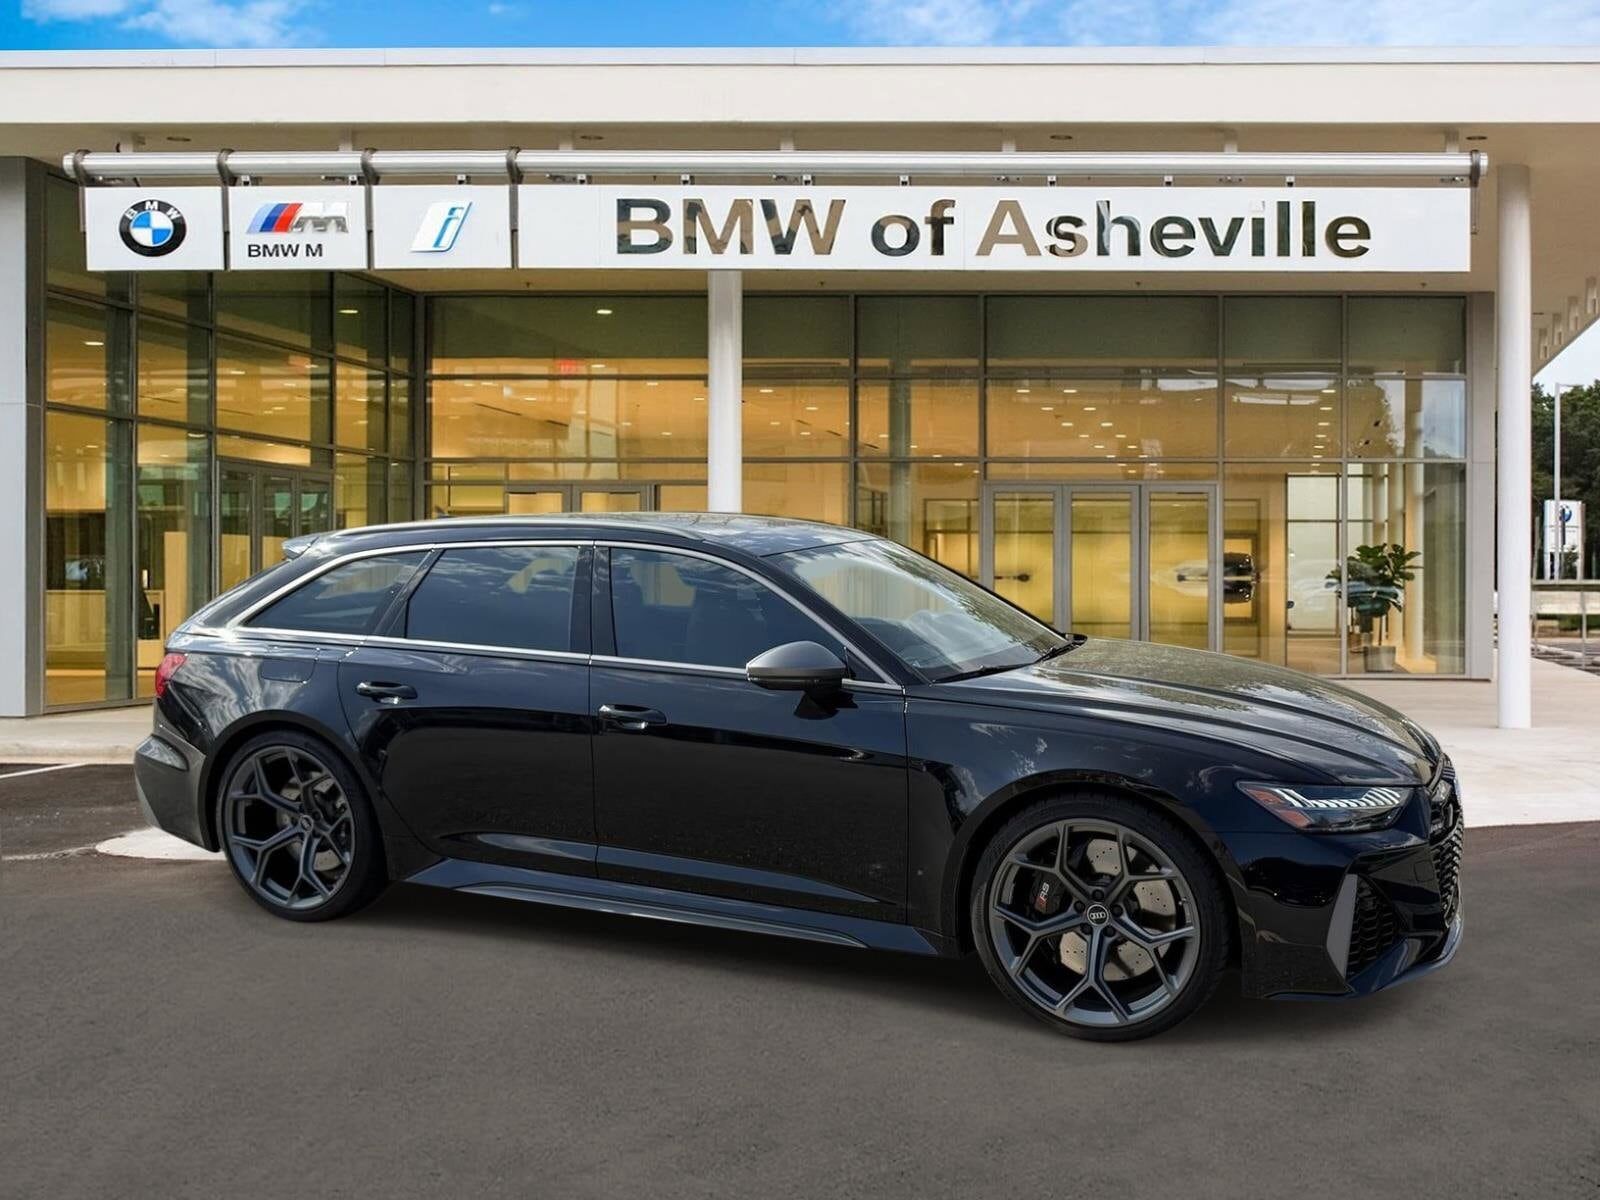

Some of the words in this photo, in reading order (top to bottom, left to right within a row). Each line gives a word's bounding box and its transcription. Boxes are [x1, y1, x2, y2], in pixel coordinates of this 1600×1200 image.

[124, 200, 181, 220] BMW
[616, 198, 847, 255] BMW
[870, 198, 957, 257] of
[975, 198, 1372, 258] Asheville
[247, 243, 300, 258] BMW
[305, 243, 323, 258] M
